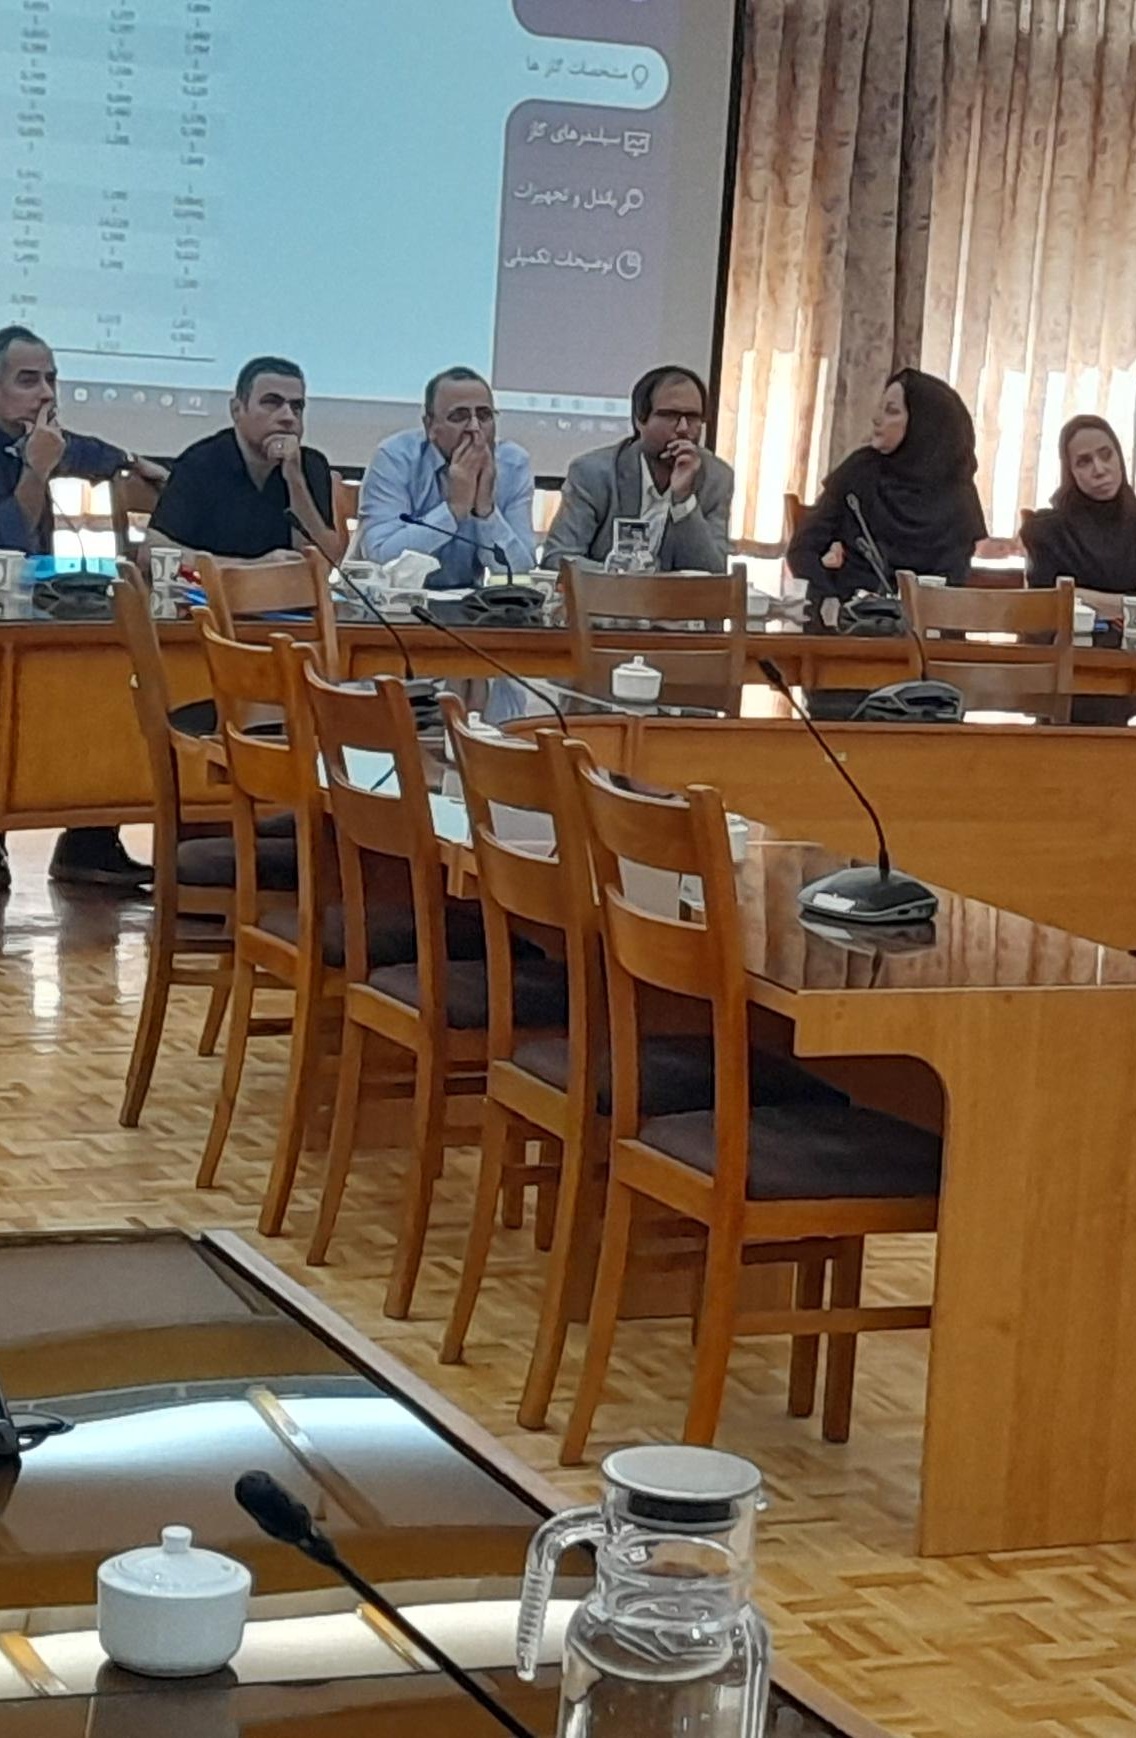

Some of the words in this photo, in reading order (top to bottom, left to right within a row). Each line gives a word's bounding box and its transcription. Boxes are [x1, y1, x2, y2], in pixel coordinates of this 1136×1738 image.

[526, 55, 540, 71] ها
[513, 182, 569, 206] تجهیزات
[573, 195, 580, 209] و
[503, 247, 552, 268] تکمیلی
[554, 249, 613, 275] توضیحات
